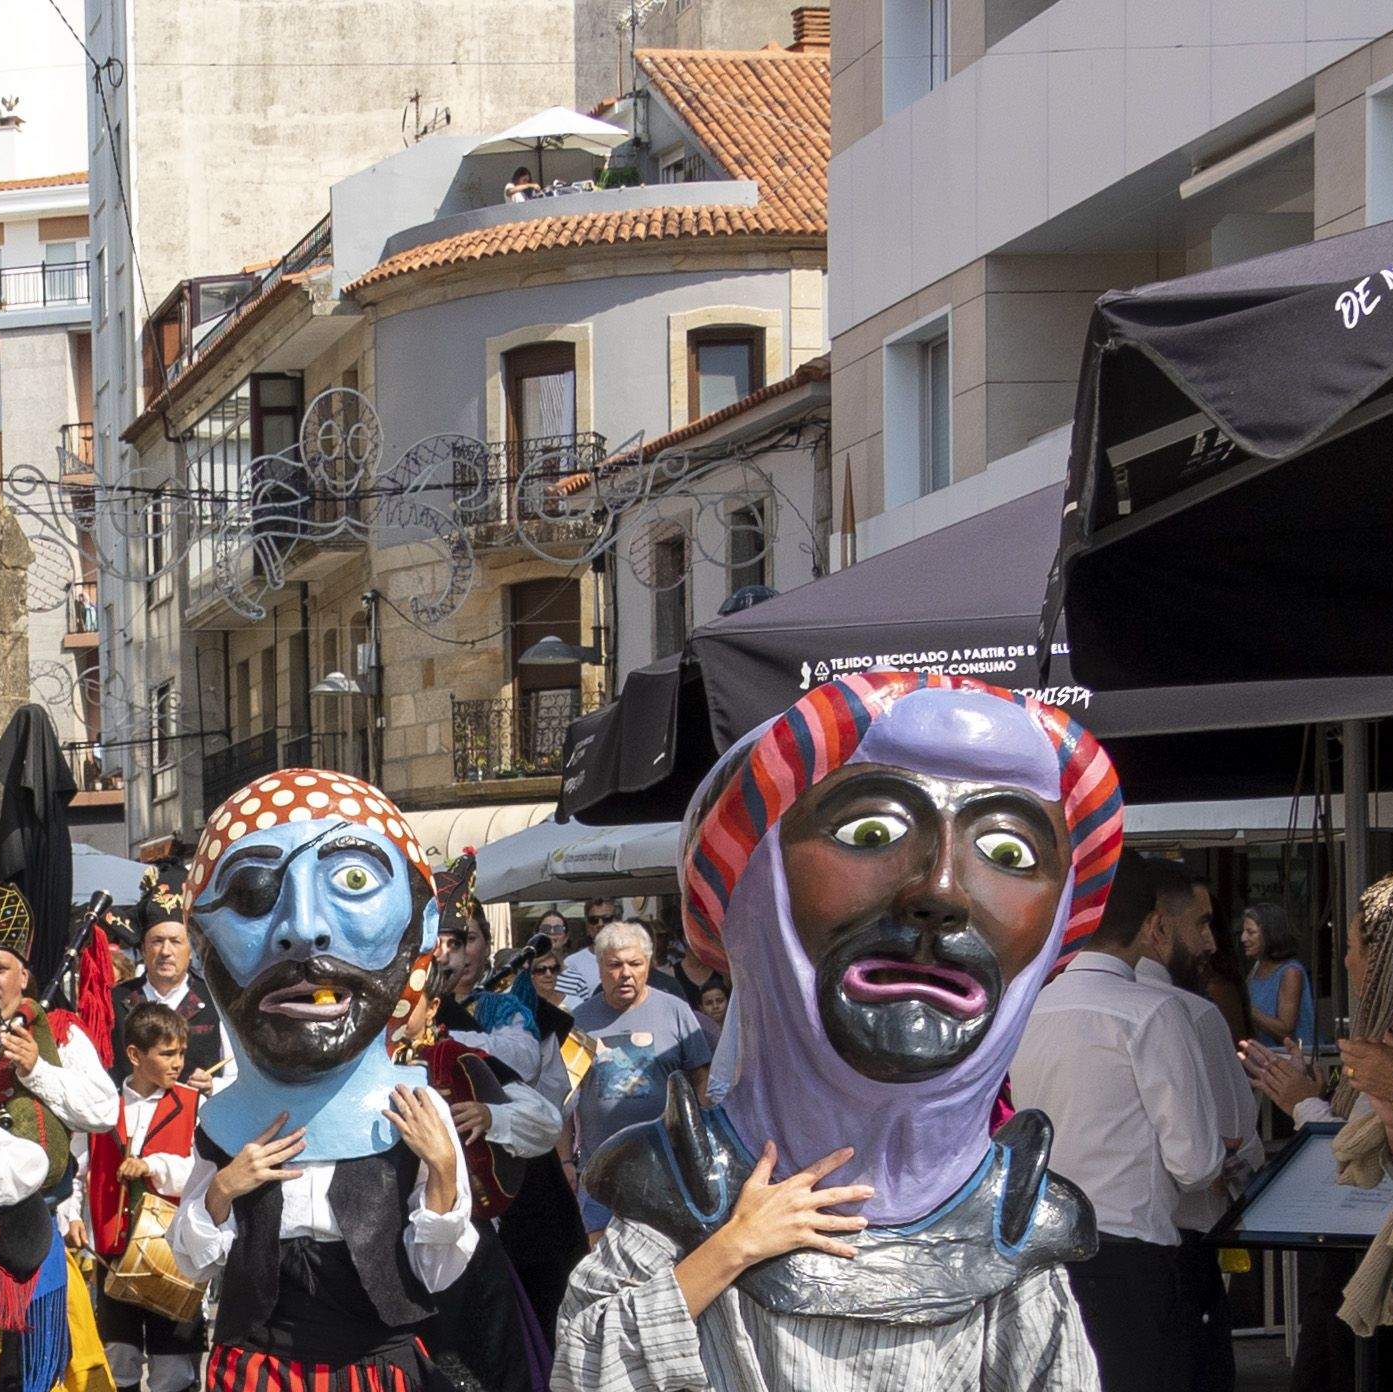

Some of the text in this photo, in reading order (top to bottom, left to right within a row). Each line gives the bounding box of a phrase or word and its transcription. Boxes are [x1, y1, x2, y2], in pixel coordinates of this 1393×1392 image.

[830, 655, 873, 671] TEJIDO
[875, 650, 949, 668] RECICLADO
[951, 649, 962, 662] A
[964, 646, 1006, 660] PARTIR
[1008, 644, 1026, 658] DE
